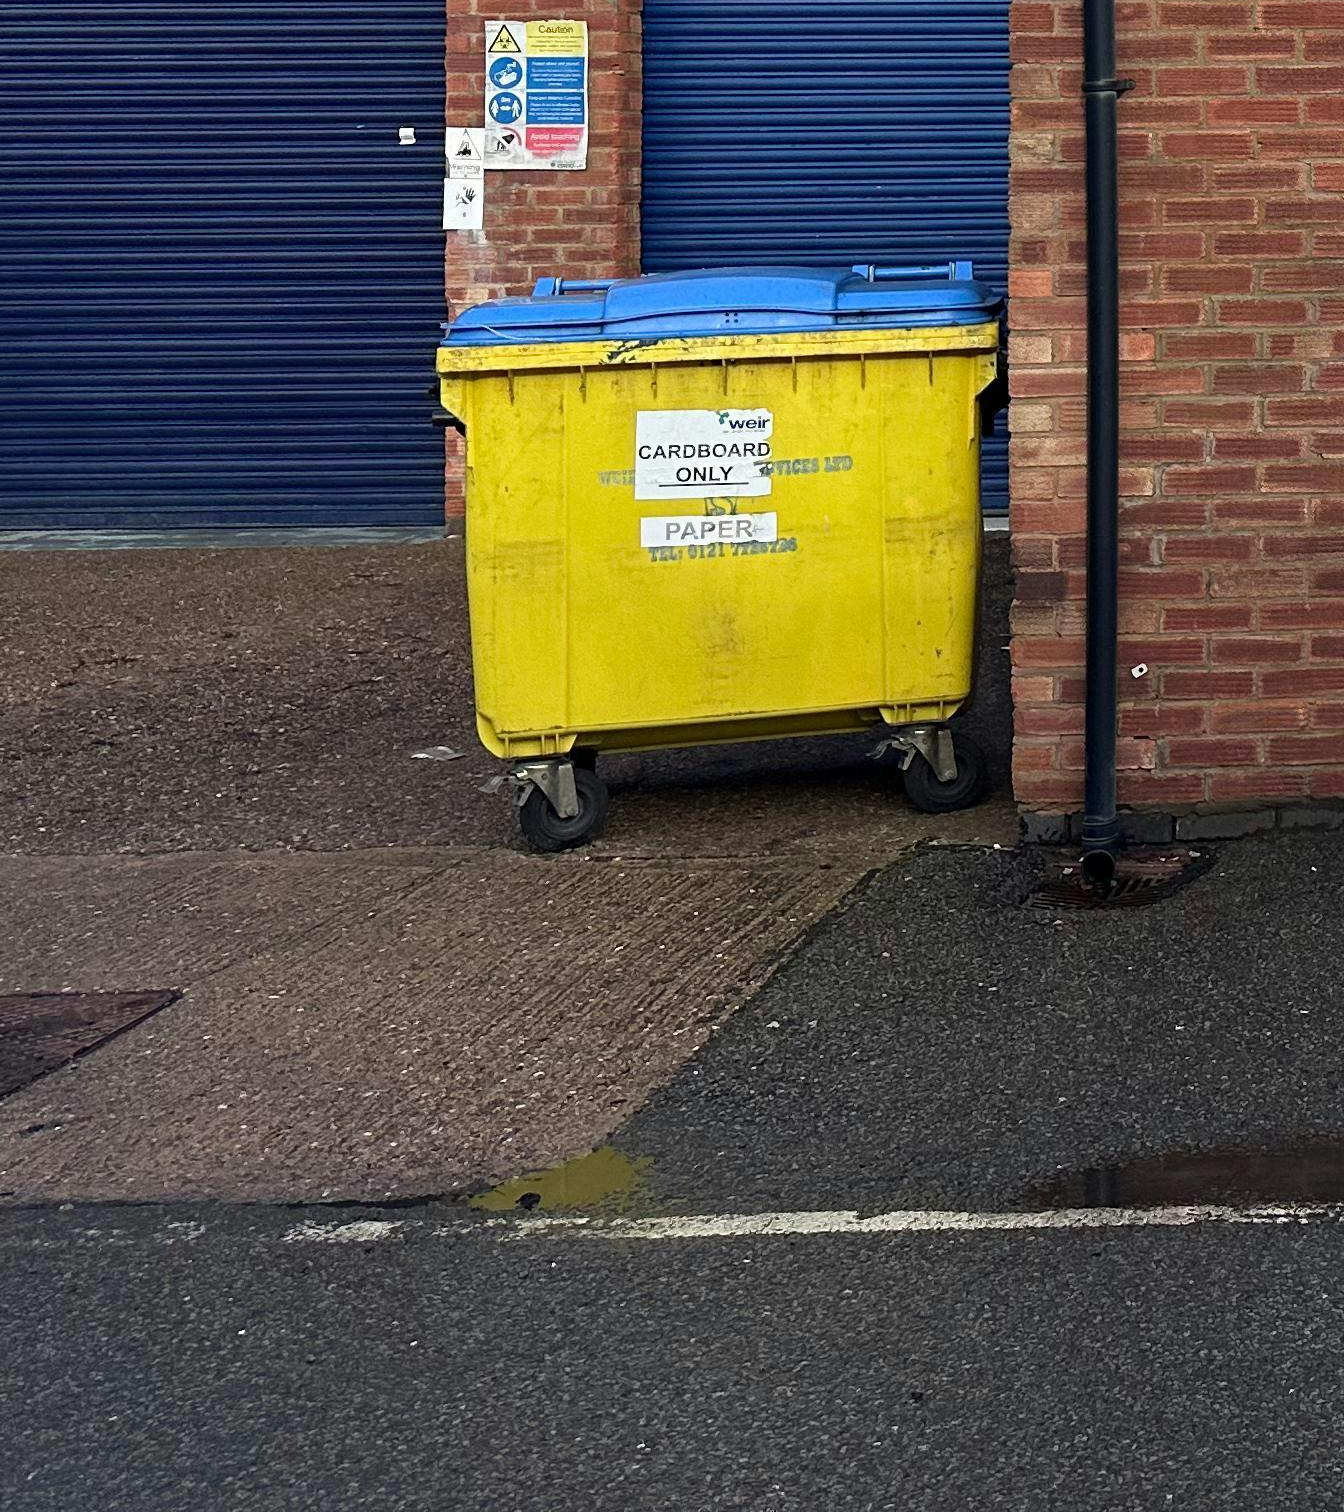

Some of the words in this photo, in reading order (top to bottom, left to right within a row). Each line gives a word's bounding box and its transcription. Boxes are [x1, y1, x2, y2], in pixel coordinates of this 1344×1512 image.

[538, 24, 574, 34] Caution
[729, 416, 770, 429] weir
[638, 442, 770, 460] CARDBOARD
[676, 466, 733, 482] ONLY
[666, 520, 752, 540] PAPER
